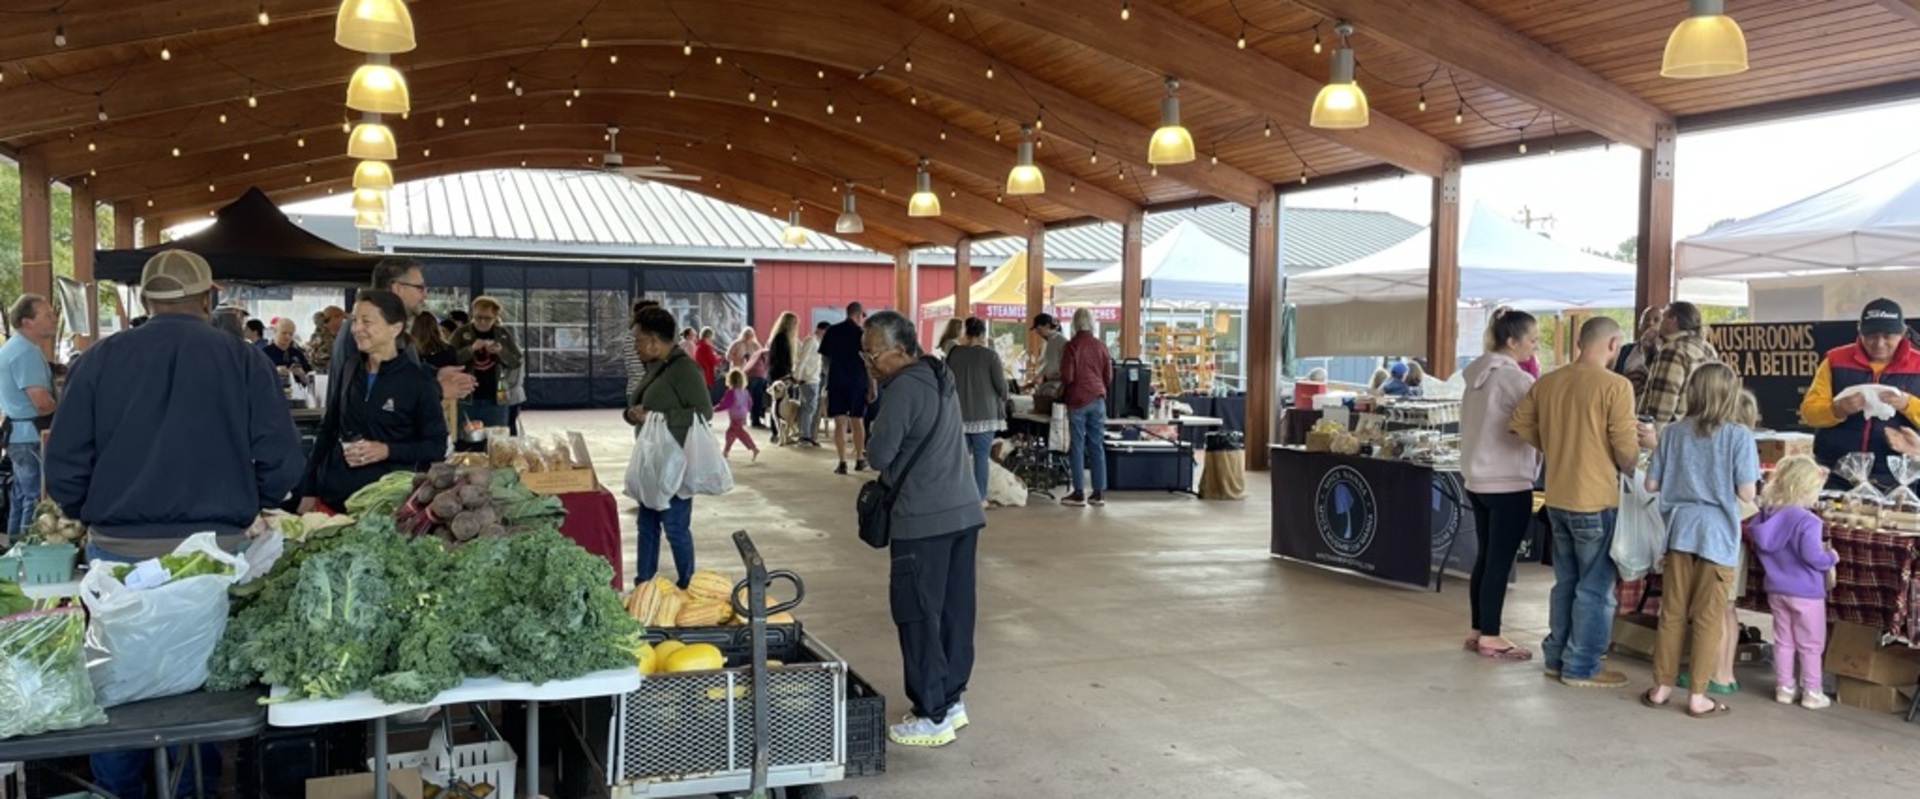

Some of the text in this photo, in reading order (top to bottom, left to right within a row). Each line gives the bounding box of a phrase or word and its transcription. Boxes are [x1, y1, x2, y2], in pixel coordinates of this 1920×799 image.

[1709, 325, 1815, 351] MUSHROOMS
[1719, 350, 1819, 377] OR A BETTER
